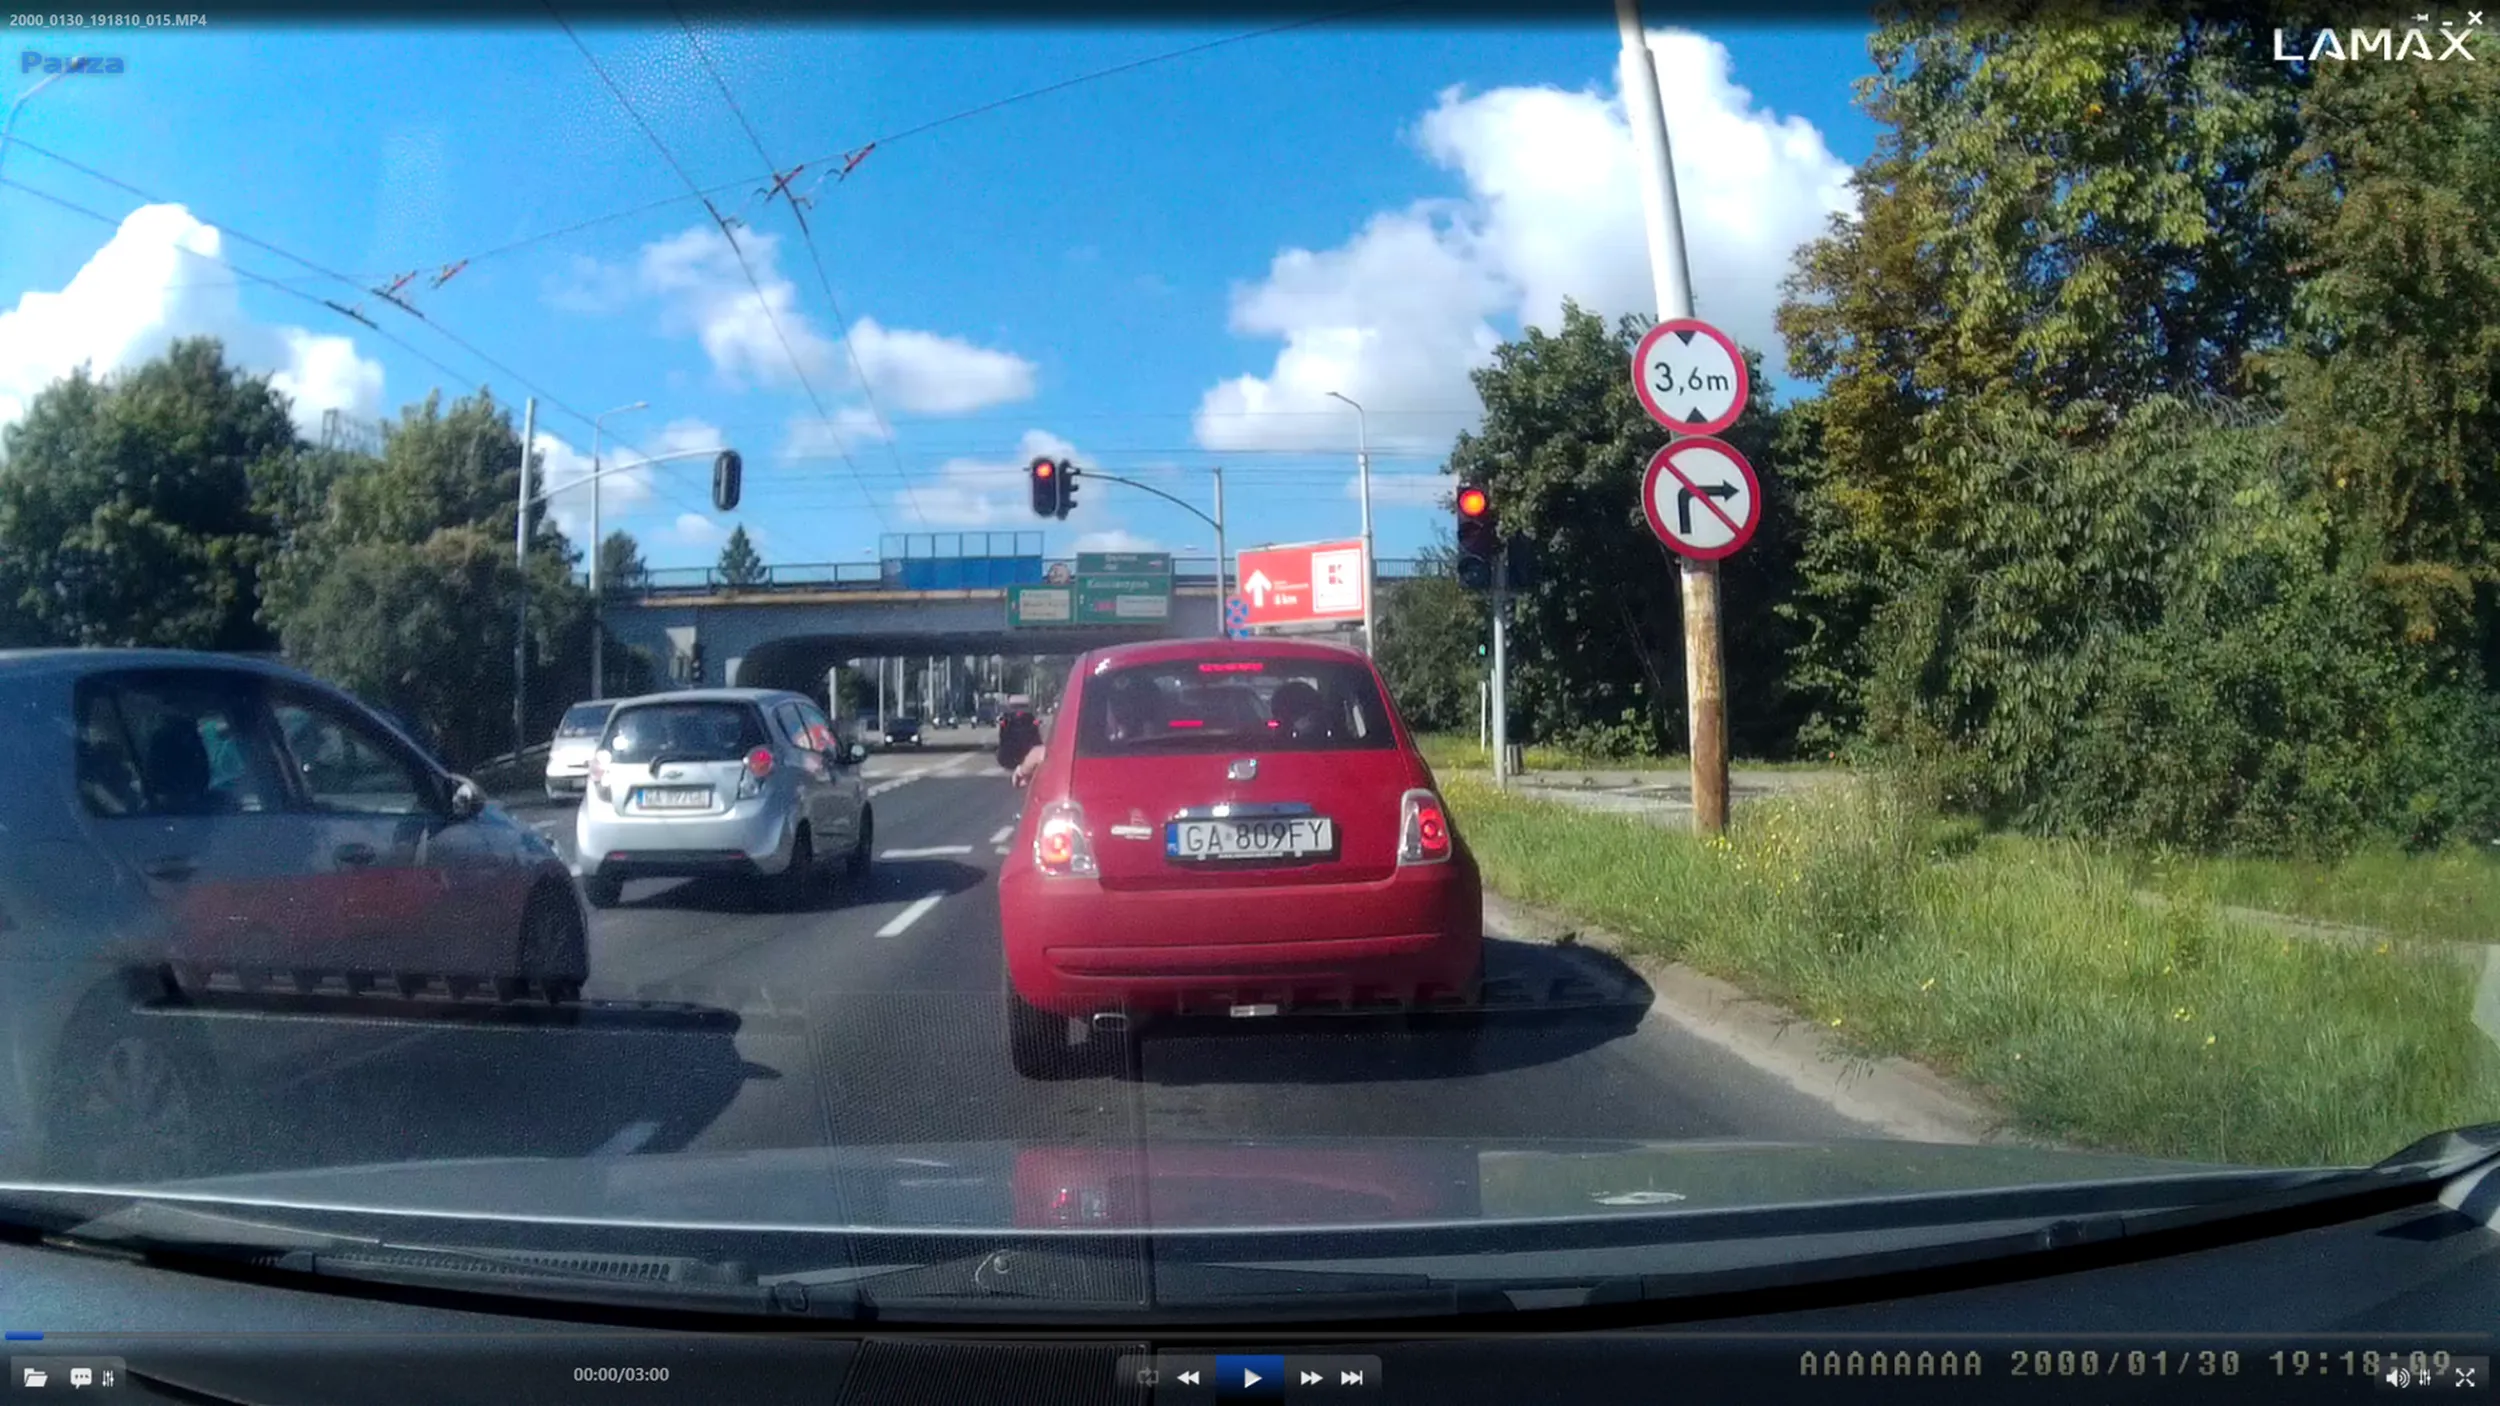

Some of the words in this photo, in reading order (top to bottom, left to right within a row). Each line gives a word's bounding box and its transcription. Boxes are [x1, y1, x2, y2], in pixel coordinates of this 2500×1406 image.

[1654, 362, 1729, 395] 3,6m
[1187, 825, 1224, 851] GA
[1236, 820, 1324, 850] 809FY
